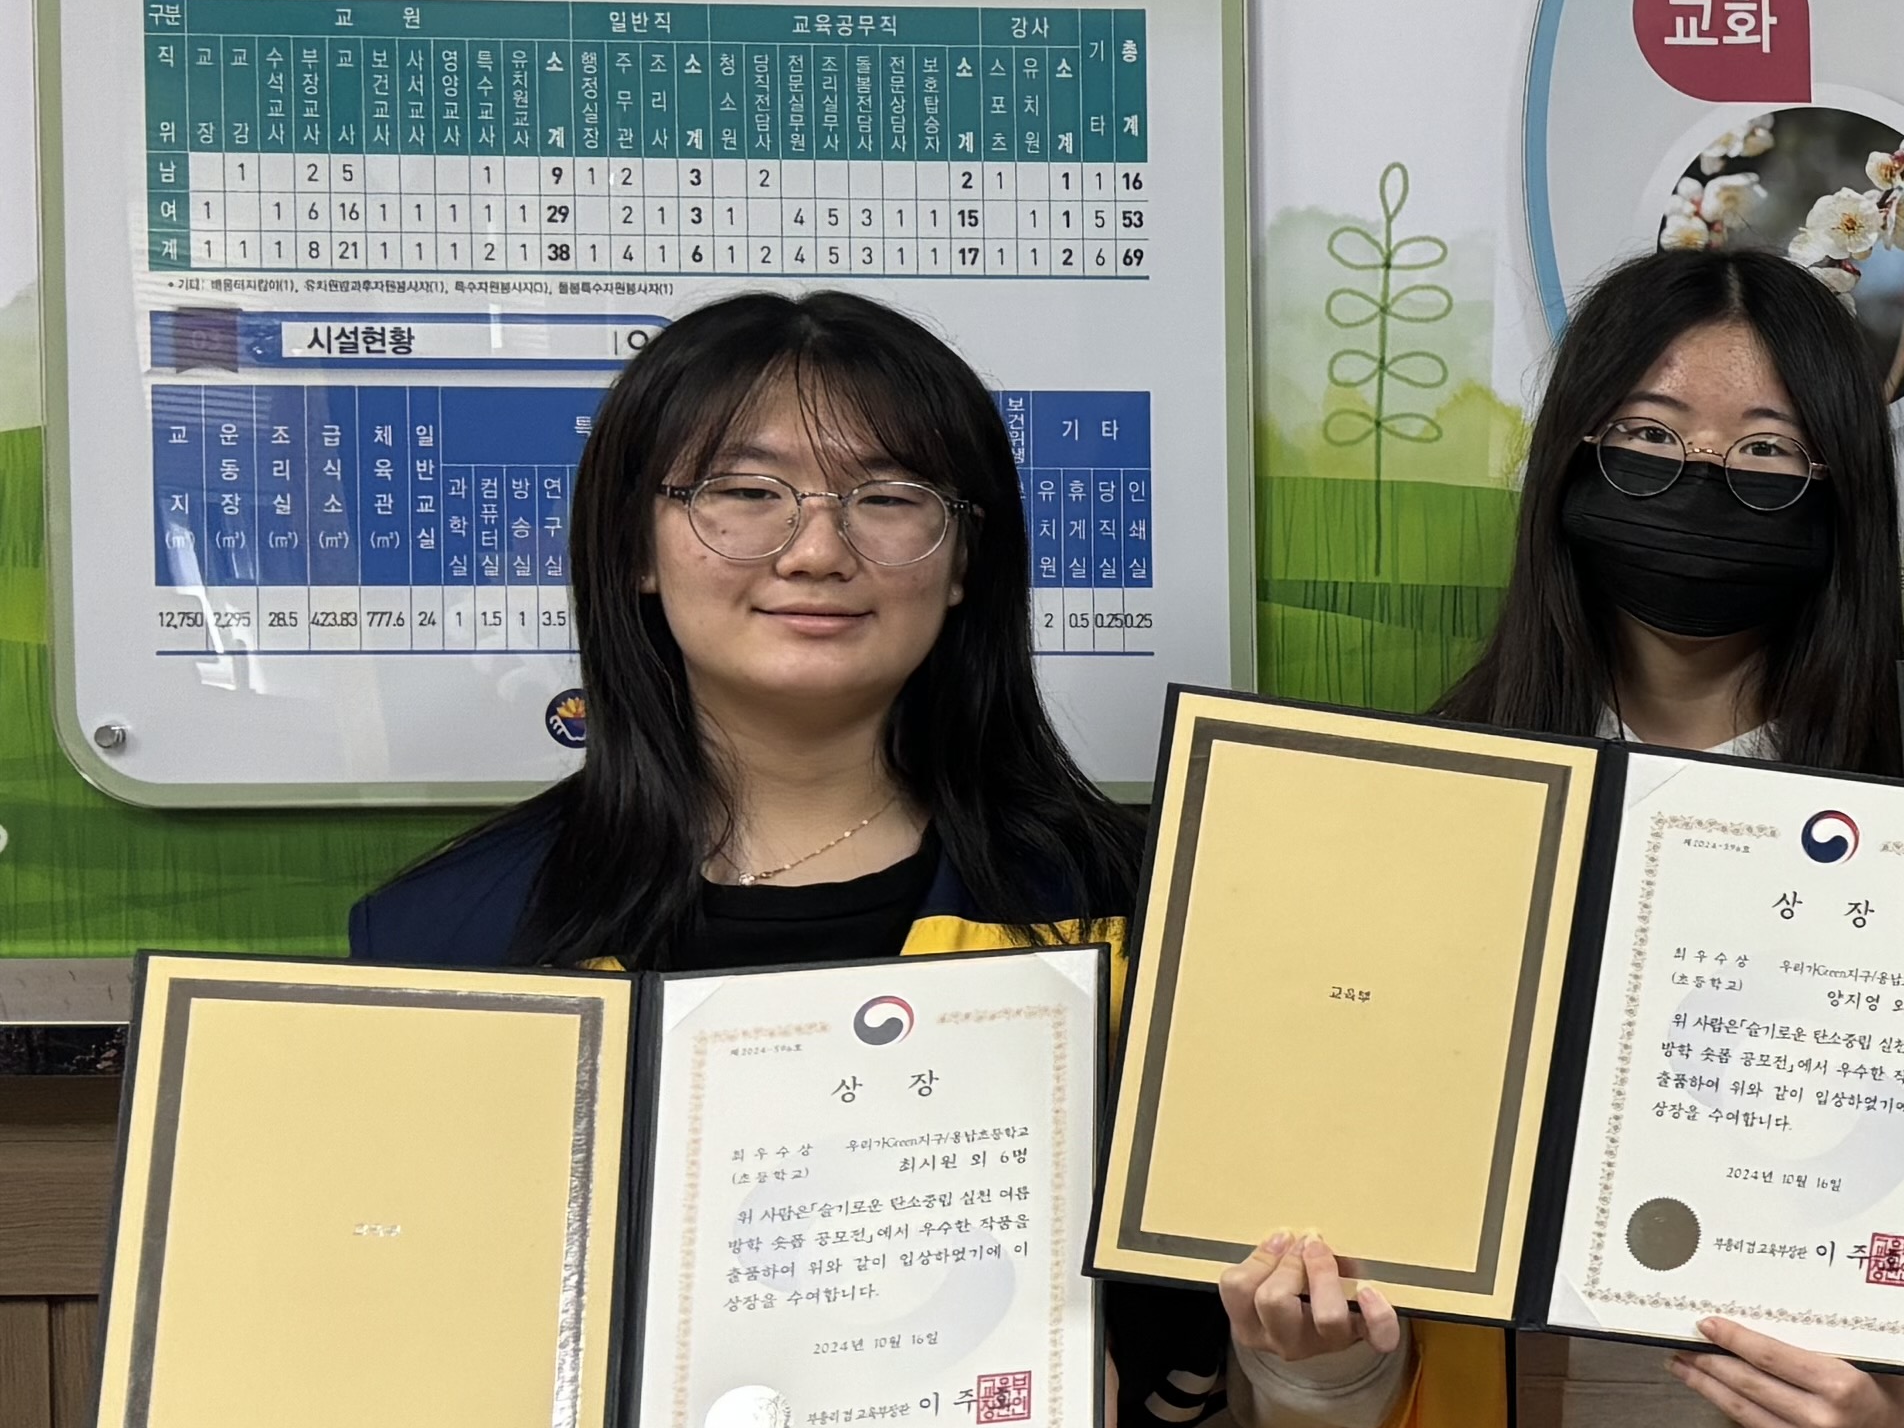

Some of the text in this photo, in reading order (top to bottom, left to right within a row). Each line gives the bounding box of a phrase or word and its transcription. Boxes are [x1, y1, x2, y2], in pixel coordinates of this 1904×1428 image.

[148, 4, 1049, 38] 구분 일반직 교육공무직 강사
[1122, 172, 1143, 190] 16
[547, 205, 1143, 228] 29 53
[548, 243, 1144, 266] 38 69
[304, 326, 415, 358] 시설현황
[268, 611, 405, 627] 28.5 777.6
